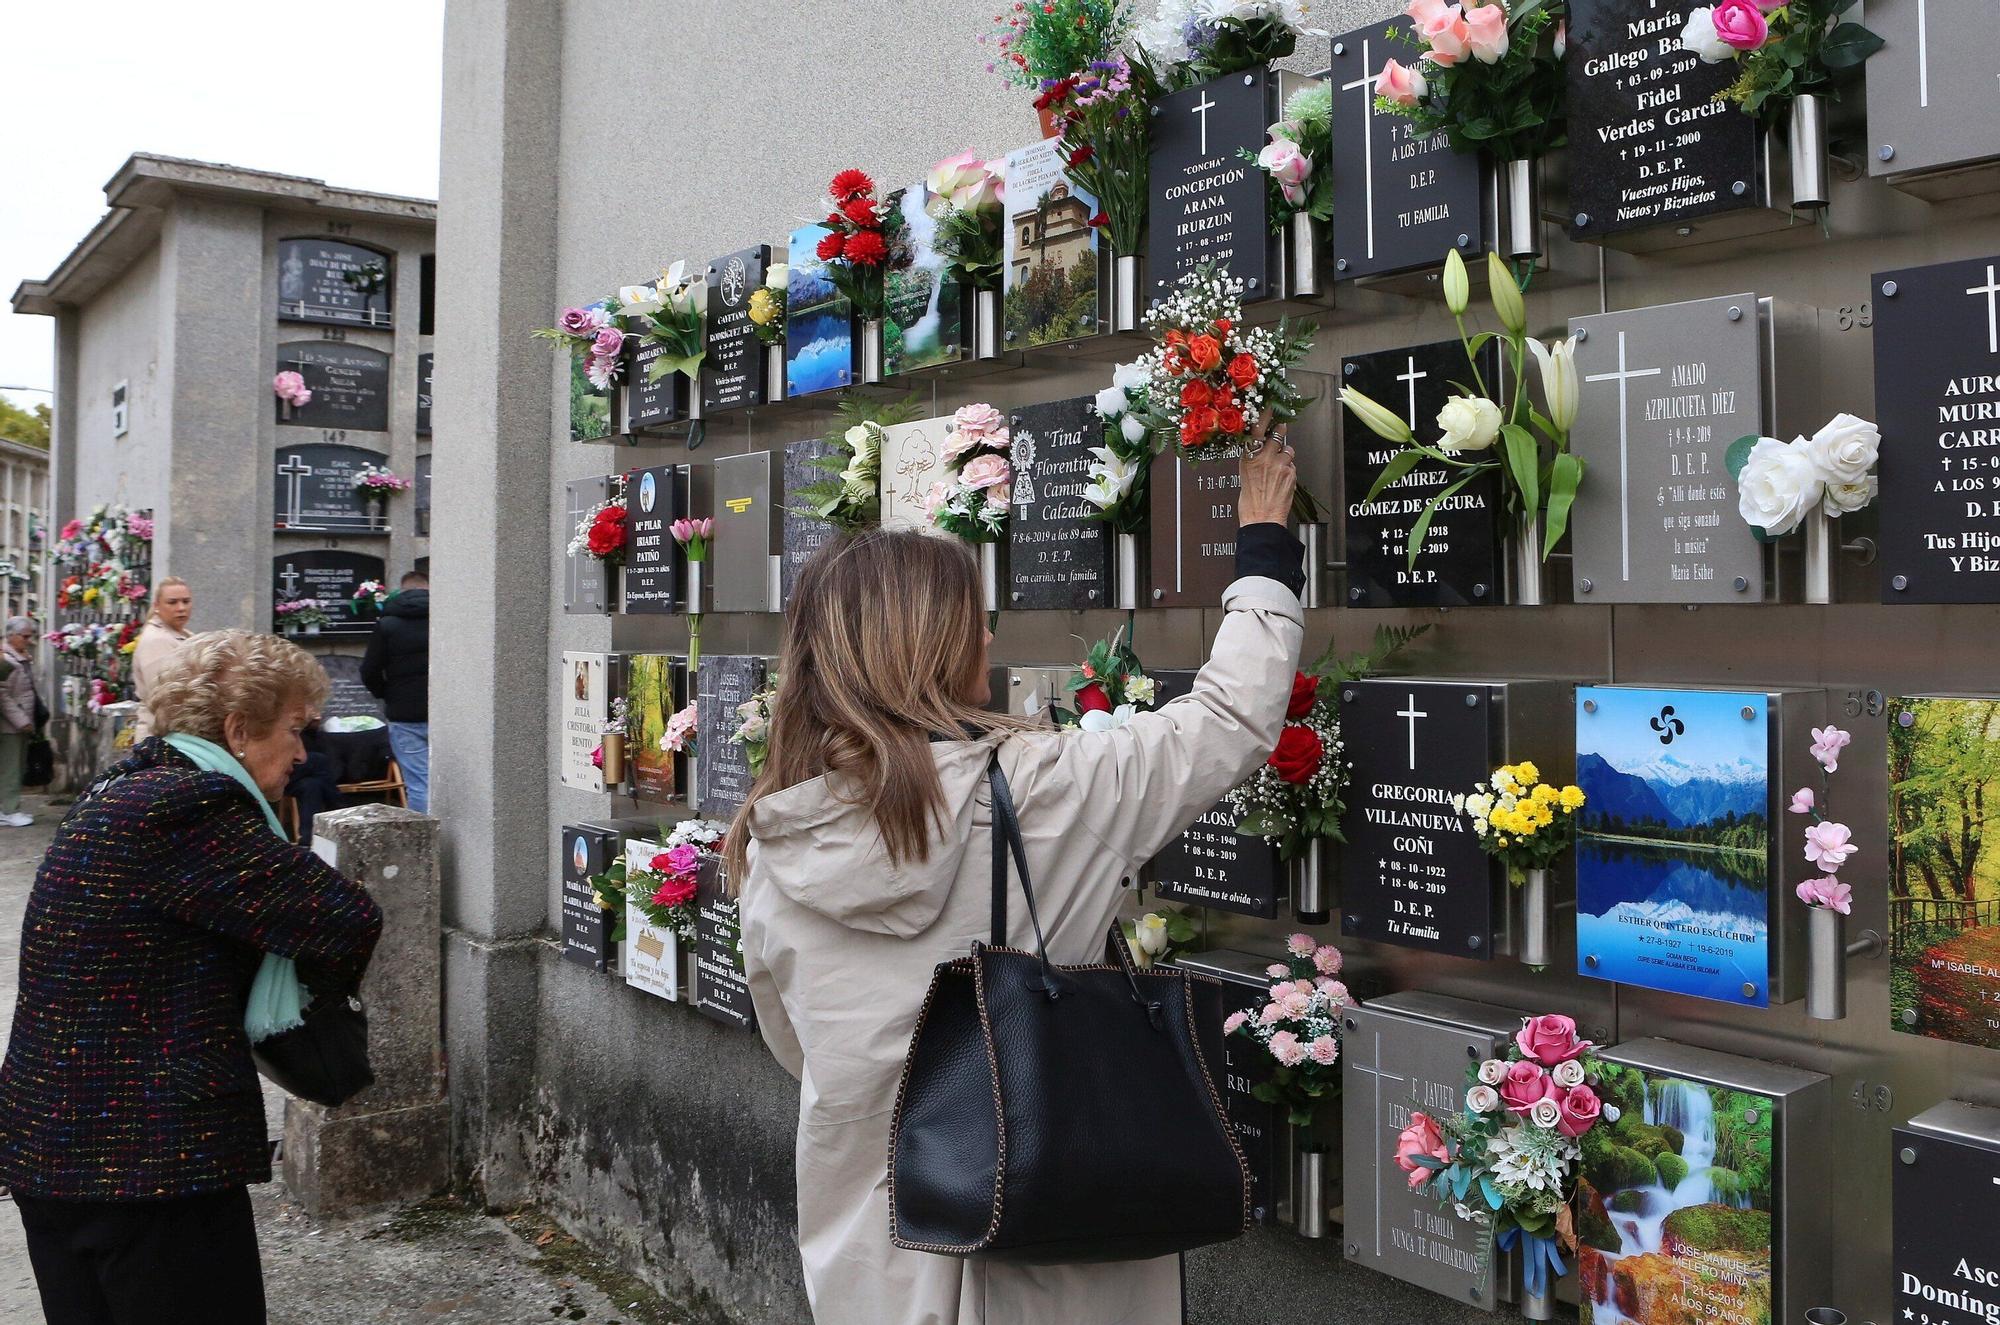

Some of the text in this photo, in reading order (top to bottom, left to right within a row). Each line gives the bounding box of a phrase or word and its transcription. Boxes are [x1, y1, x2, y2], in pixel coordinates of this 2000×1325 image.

[1627, 11, 1681, 40] María
[1584, 48, 1648, 77] Gallego
[1636, 84, 1681, 110] Fidel
[1597, 100, 1726, 144] Verdes García
[1392, 132, 1450, 162] A LOS 71 AÑO
[1166, 168, 1244, 200] CONCEPCIÓN
[1621, 176, 1706, 202] Vuestros Hijos,
[1184, 194, 1225, 214] ARANA
[1616, 190, 1716, 222] Nietos y Biznietos
[1177, 212, 1232, 236] IRURZUN
[1398, 204, 1450, 228] TU FAMILIA
[1671, 362, 1706, 388] AMADO
[1645, 388, 1736, 421] AZPILICUETA DÍEZ
[1934, 478, 1984, 492] A LOS
[1042, 500, 1091, 520] Calzada
[1350, 500, 1400, 517] GÓMEZ
[1403, 499, 1422, 514] DE
[644, 520, 662, 530] PILAR
[1080, 528, 1098, 538] años
[636, 536, 660, 546] IRIARTE
[1202, 544, 1210, 556] TU
[1924, 534, 1956, 550] Tus
[636, 549, 660, 562] PATIÑO
[1950, 556, 1964, 572] Y
[1068, 568, 1097, 585] familia
[1694, 564, 1714, 580] Esther
[1372, 784, 1454, 804] GREGORIA
[1365, 808, 1464, 832] VILLANUEVA
[1393, 836, 1434, 855] GOÑI
[1173, 881, 1251, 905] Tu Familia no te olvida
[1388, 920, 1440, 940] Tu Familia
[1619, 915, 1756, 943] ESTHER QUINTERO ESCUCHURI
[1948, 962, 1985, 976] ISABEL
[1987, 1019, 1999, 1028] TU
[1425, 1081, 1455, 1112] JAVIER
[1414, 1209, 1454, 1240] TU FAMILIA
[1392, 1227, 1478, 1274] NUNCA TE OLVIDAREMOS
[1673, 1255, 1718, 1278] MELERO
[1704, 1252, 1750, 1275] MANUEL
[1672, 1293, 1679, 1303] A
[1681, 1296, 1702, 1312] LOS
[1705, 1304, 1718, 1317] 56
[1693, 1285, 1744, 1309] 21-5-2019
